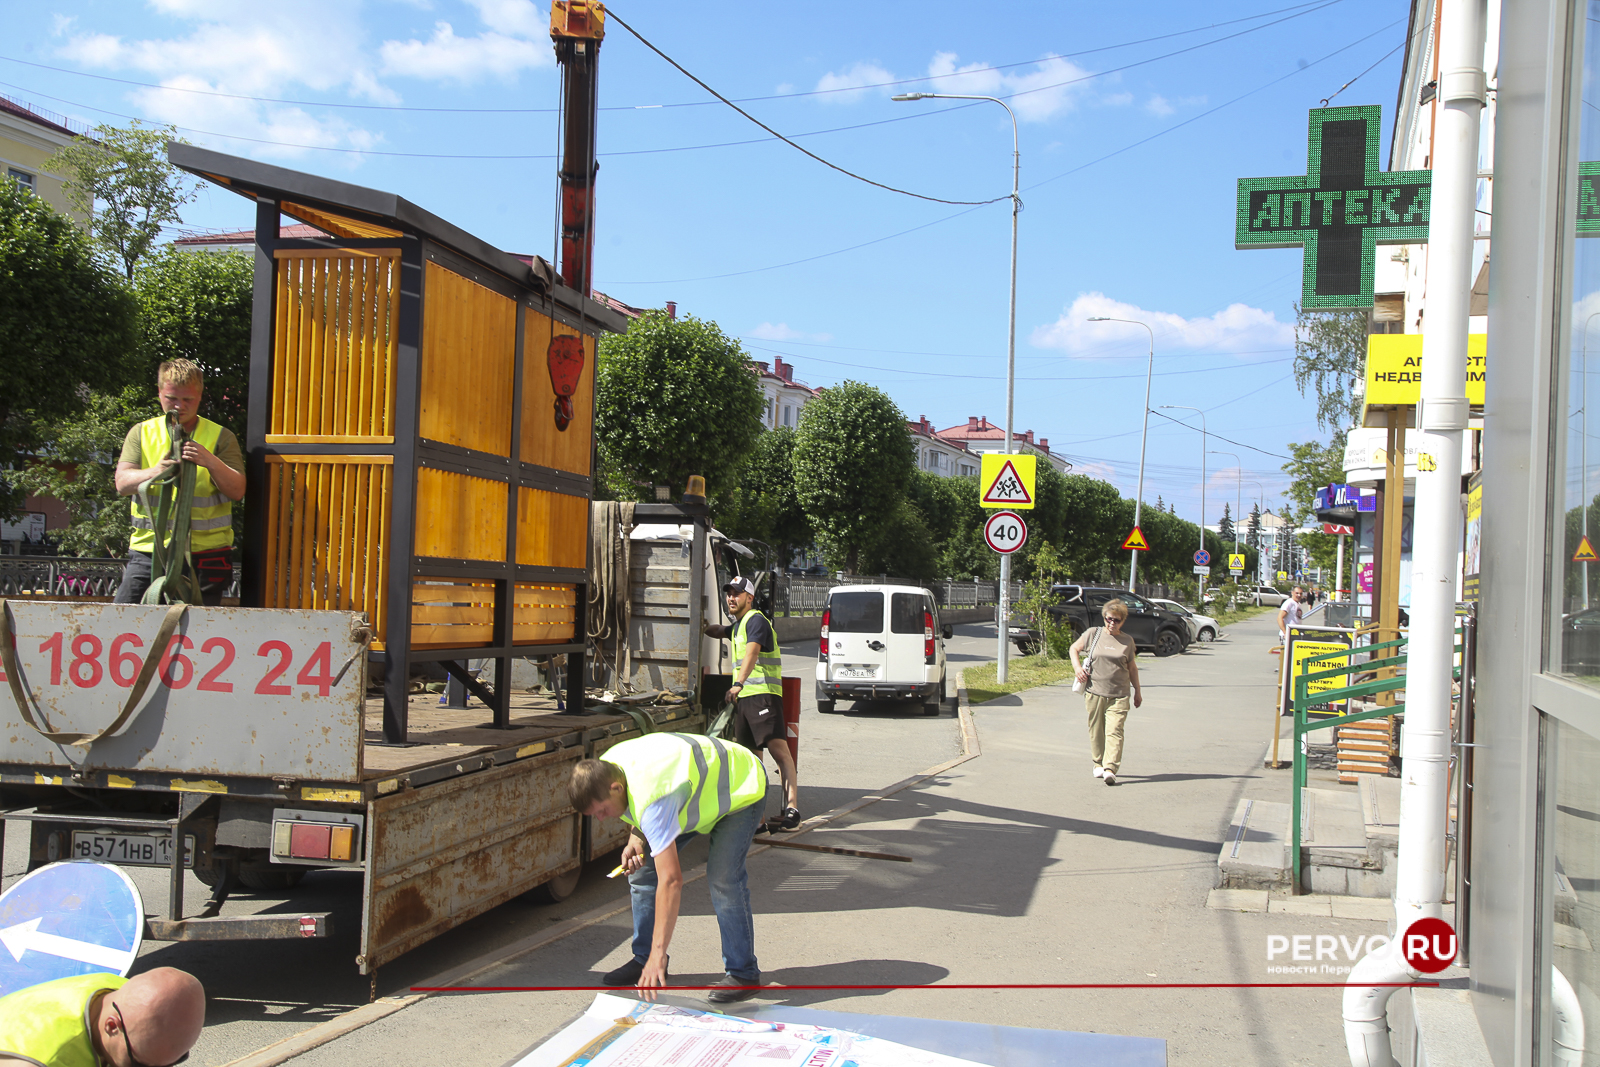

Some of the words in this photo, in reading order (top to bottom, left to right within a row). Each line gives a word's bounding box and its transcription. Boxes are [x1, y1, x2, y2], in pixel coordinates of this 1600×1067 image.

[1253, 187, 1431, 228] АПТЕКА
[993, 524, 1018, 541] 40
[39, 631, 144, 688] 186
[158, 634, 236, 693] 62
[254, 640, 336, 697] 24
[81, 837, 153, 860] В571НВ
